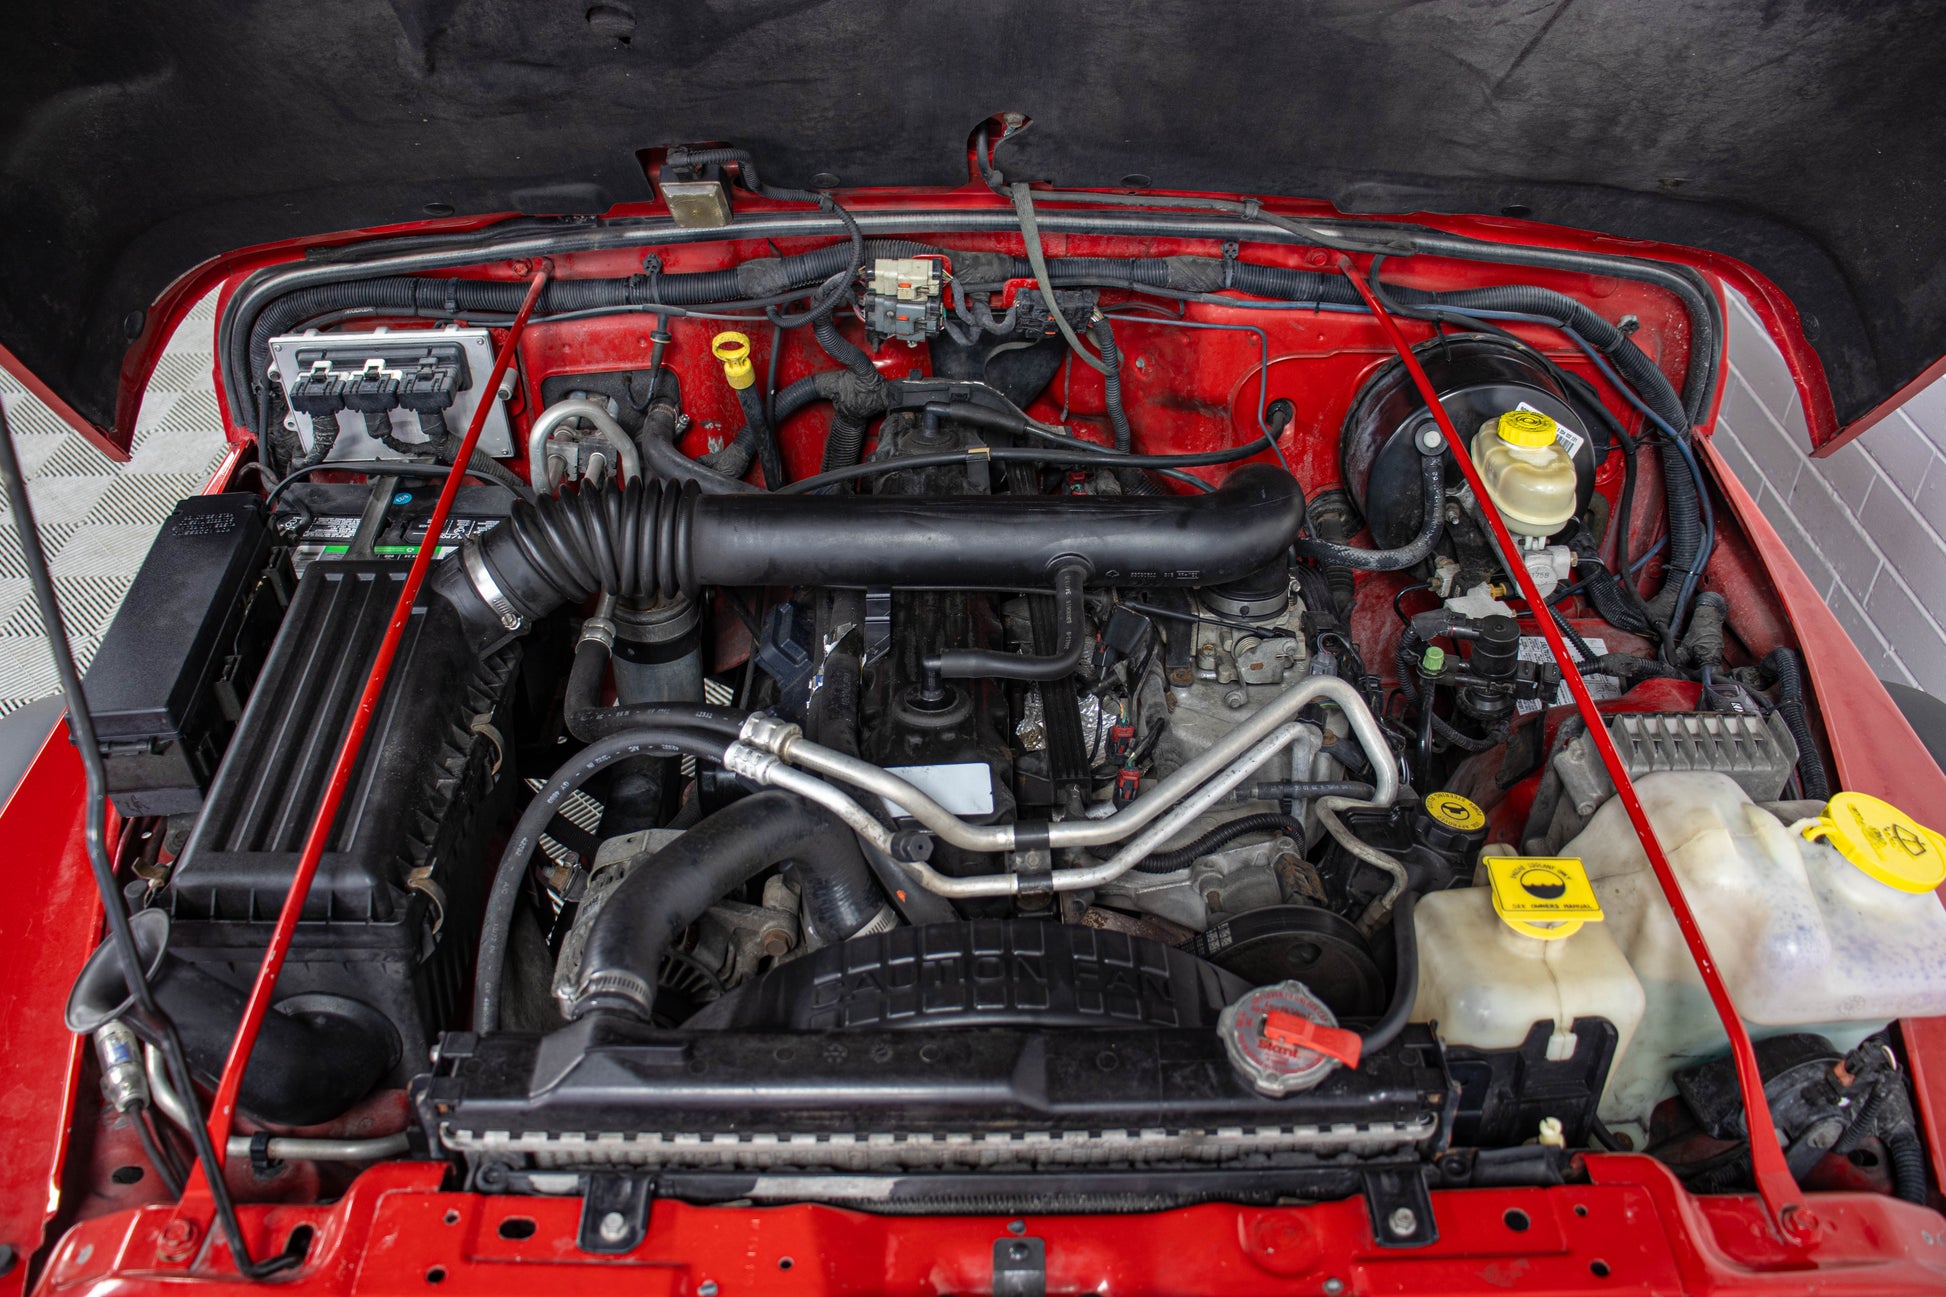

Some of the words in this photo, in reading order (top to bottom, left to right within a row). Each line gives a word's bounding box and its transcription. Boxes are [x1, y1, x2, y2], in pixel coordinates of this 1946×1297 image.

[810, 957, 1048, 1009] CAUTION
[1074, 960, 1174, 1003] FAN
[1257, 1037, 1300, 1058] Stant
